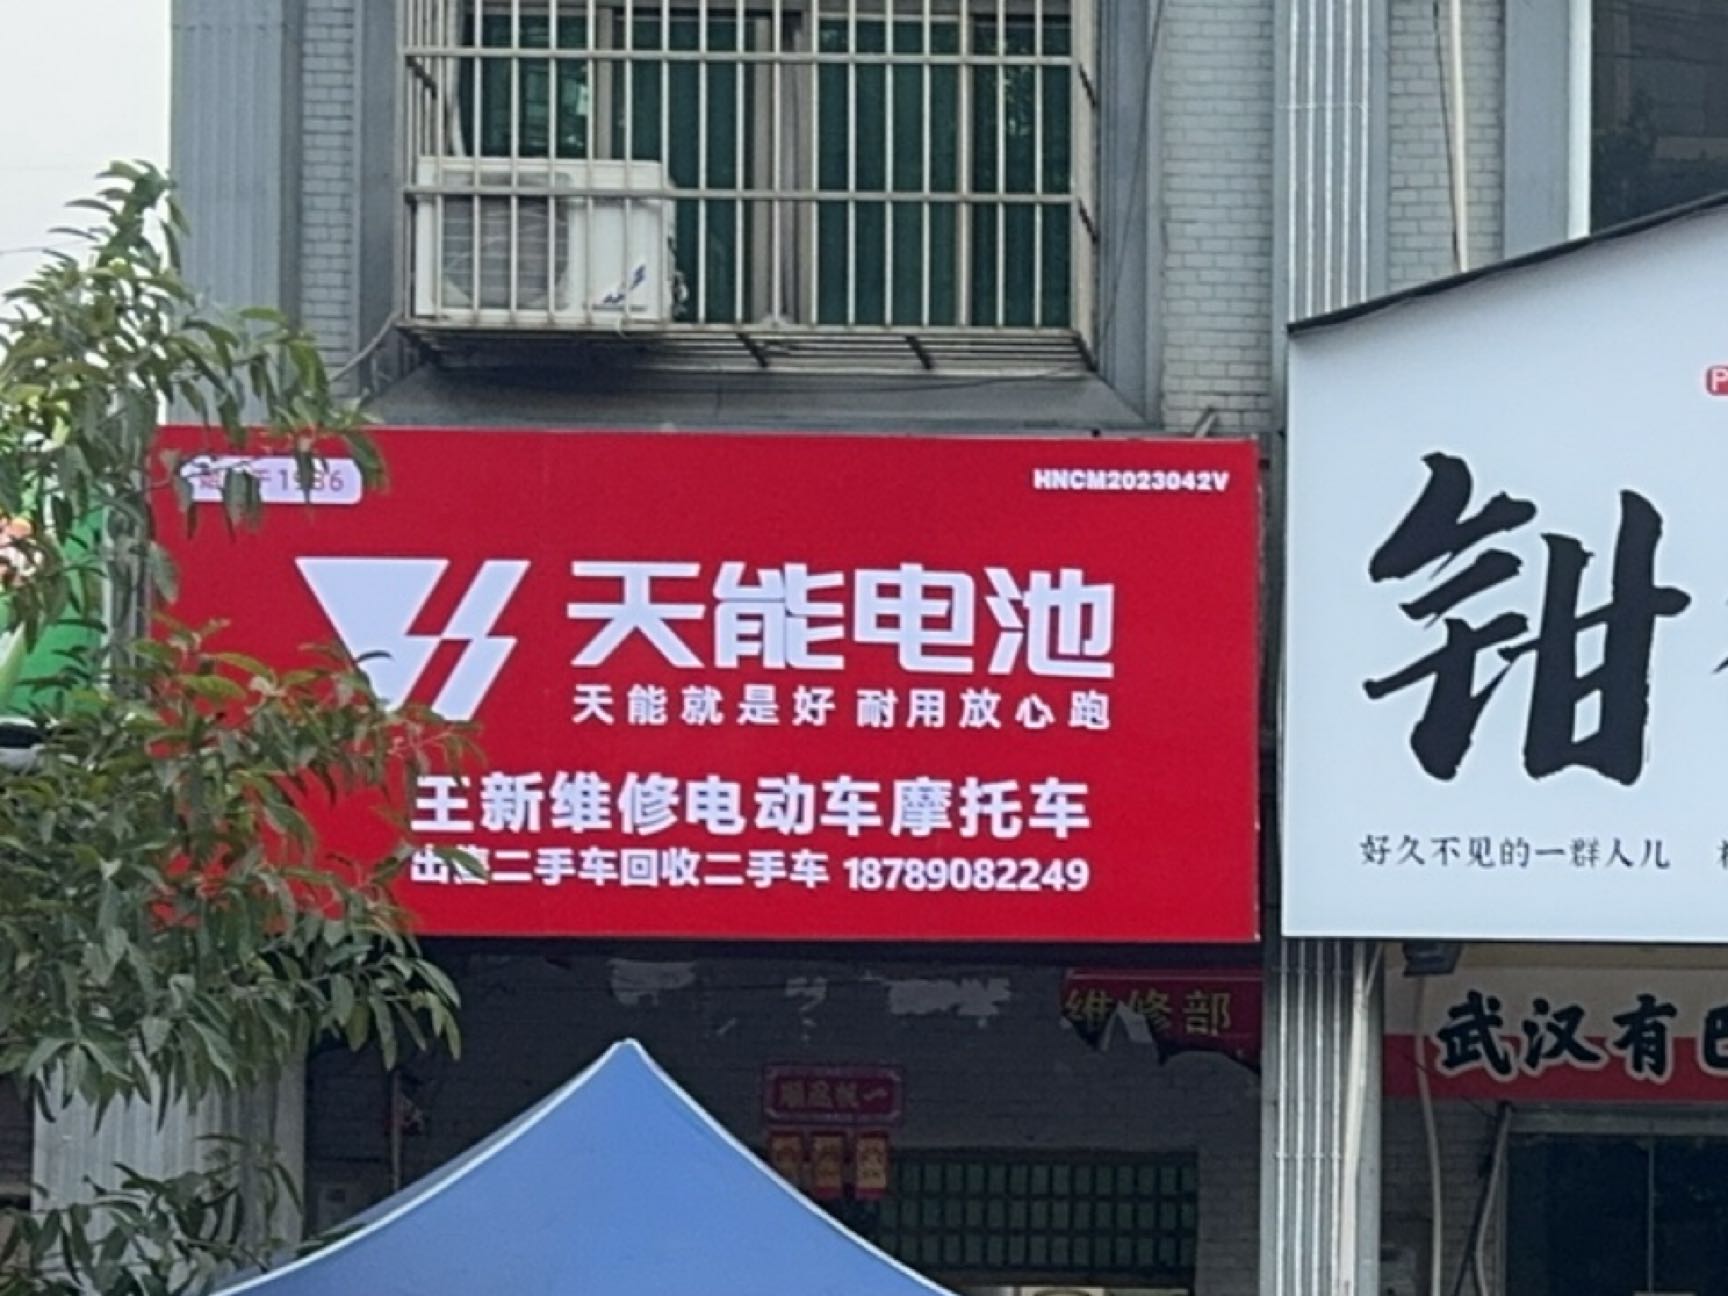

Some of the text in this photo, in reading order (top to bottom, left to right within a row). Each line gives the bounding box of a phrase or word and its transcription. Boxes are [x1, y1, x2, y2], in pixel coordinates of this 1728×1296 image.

[1033, 468, 1230, 492] HNCM2023042V
[567, 560, 1115, 679] 天能电池
[572, 683, 1112, 731] 天能就是好 耐用放心跑
[410, 771, 1091, 839] 王新维修电动车摩托车
[1360, 834, 1671, 869] 好久不见的一群人儿
[843, 856, 1090, 892] 18789082249
